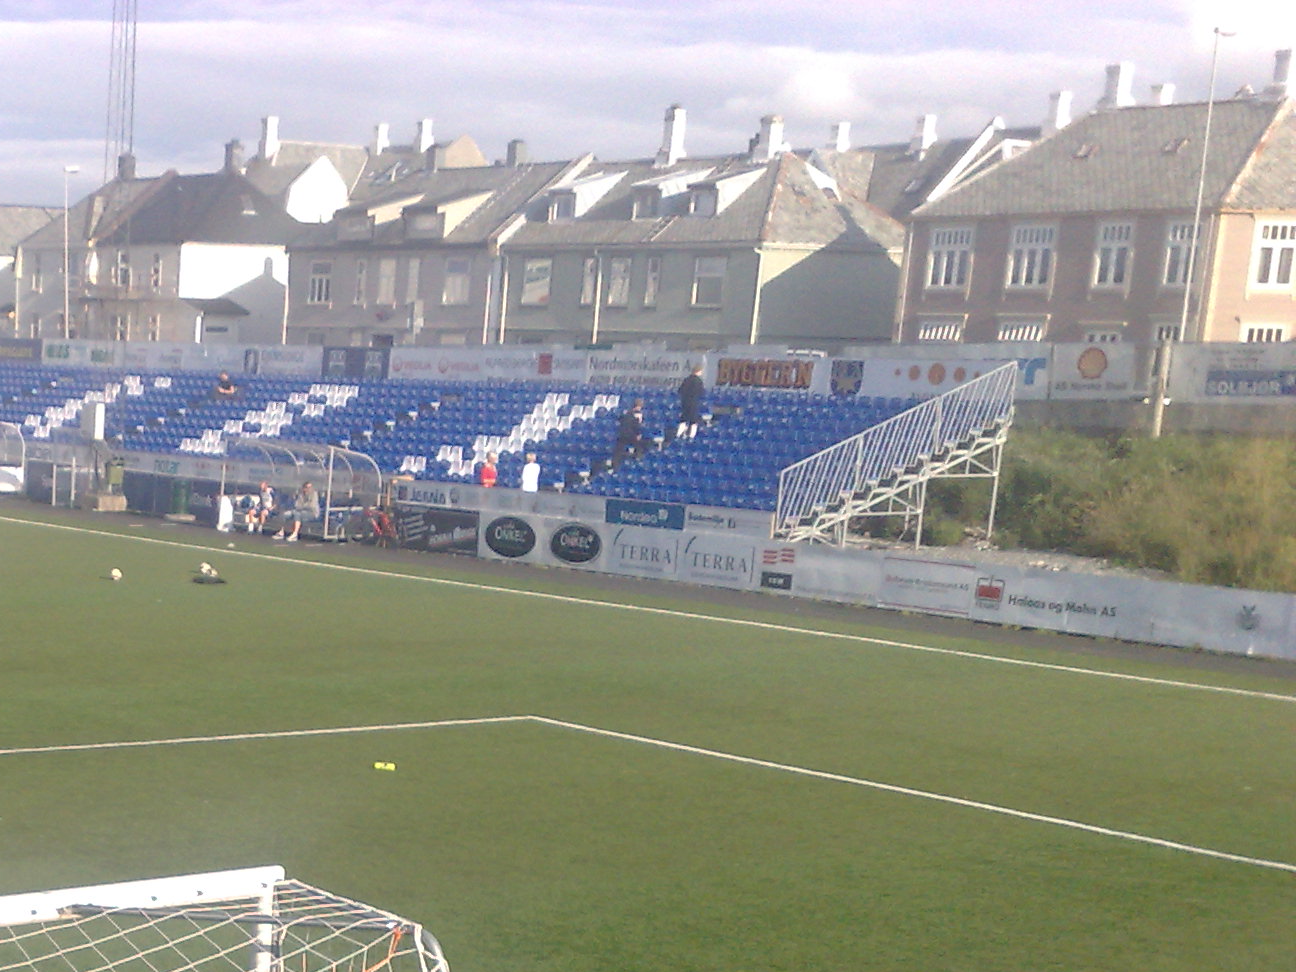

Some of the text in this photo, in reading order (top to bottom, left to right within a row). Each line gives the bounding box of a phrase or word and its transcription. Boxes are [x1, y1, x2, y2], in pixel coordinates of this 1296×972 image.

[619, 543, 671, 564] TERRA
[691, 551, 747, 573] TERRA
[1100, 606, 1117, 617] AS
